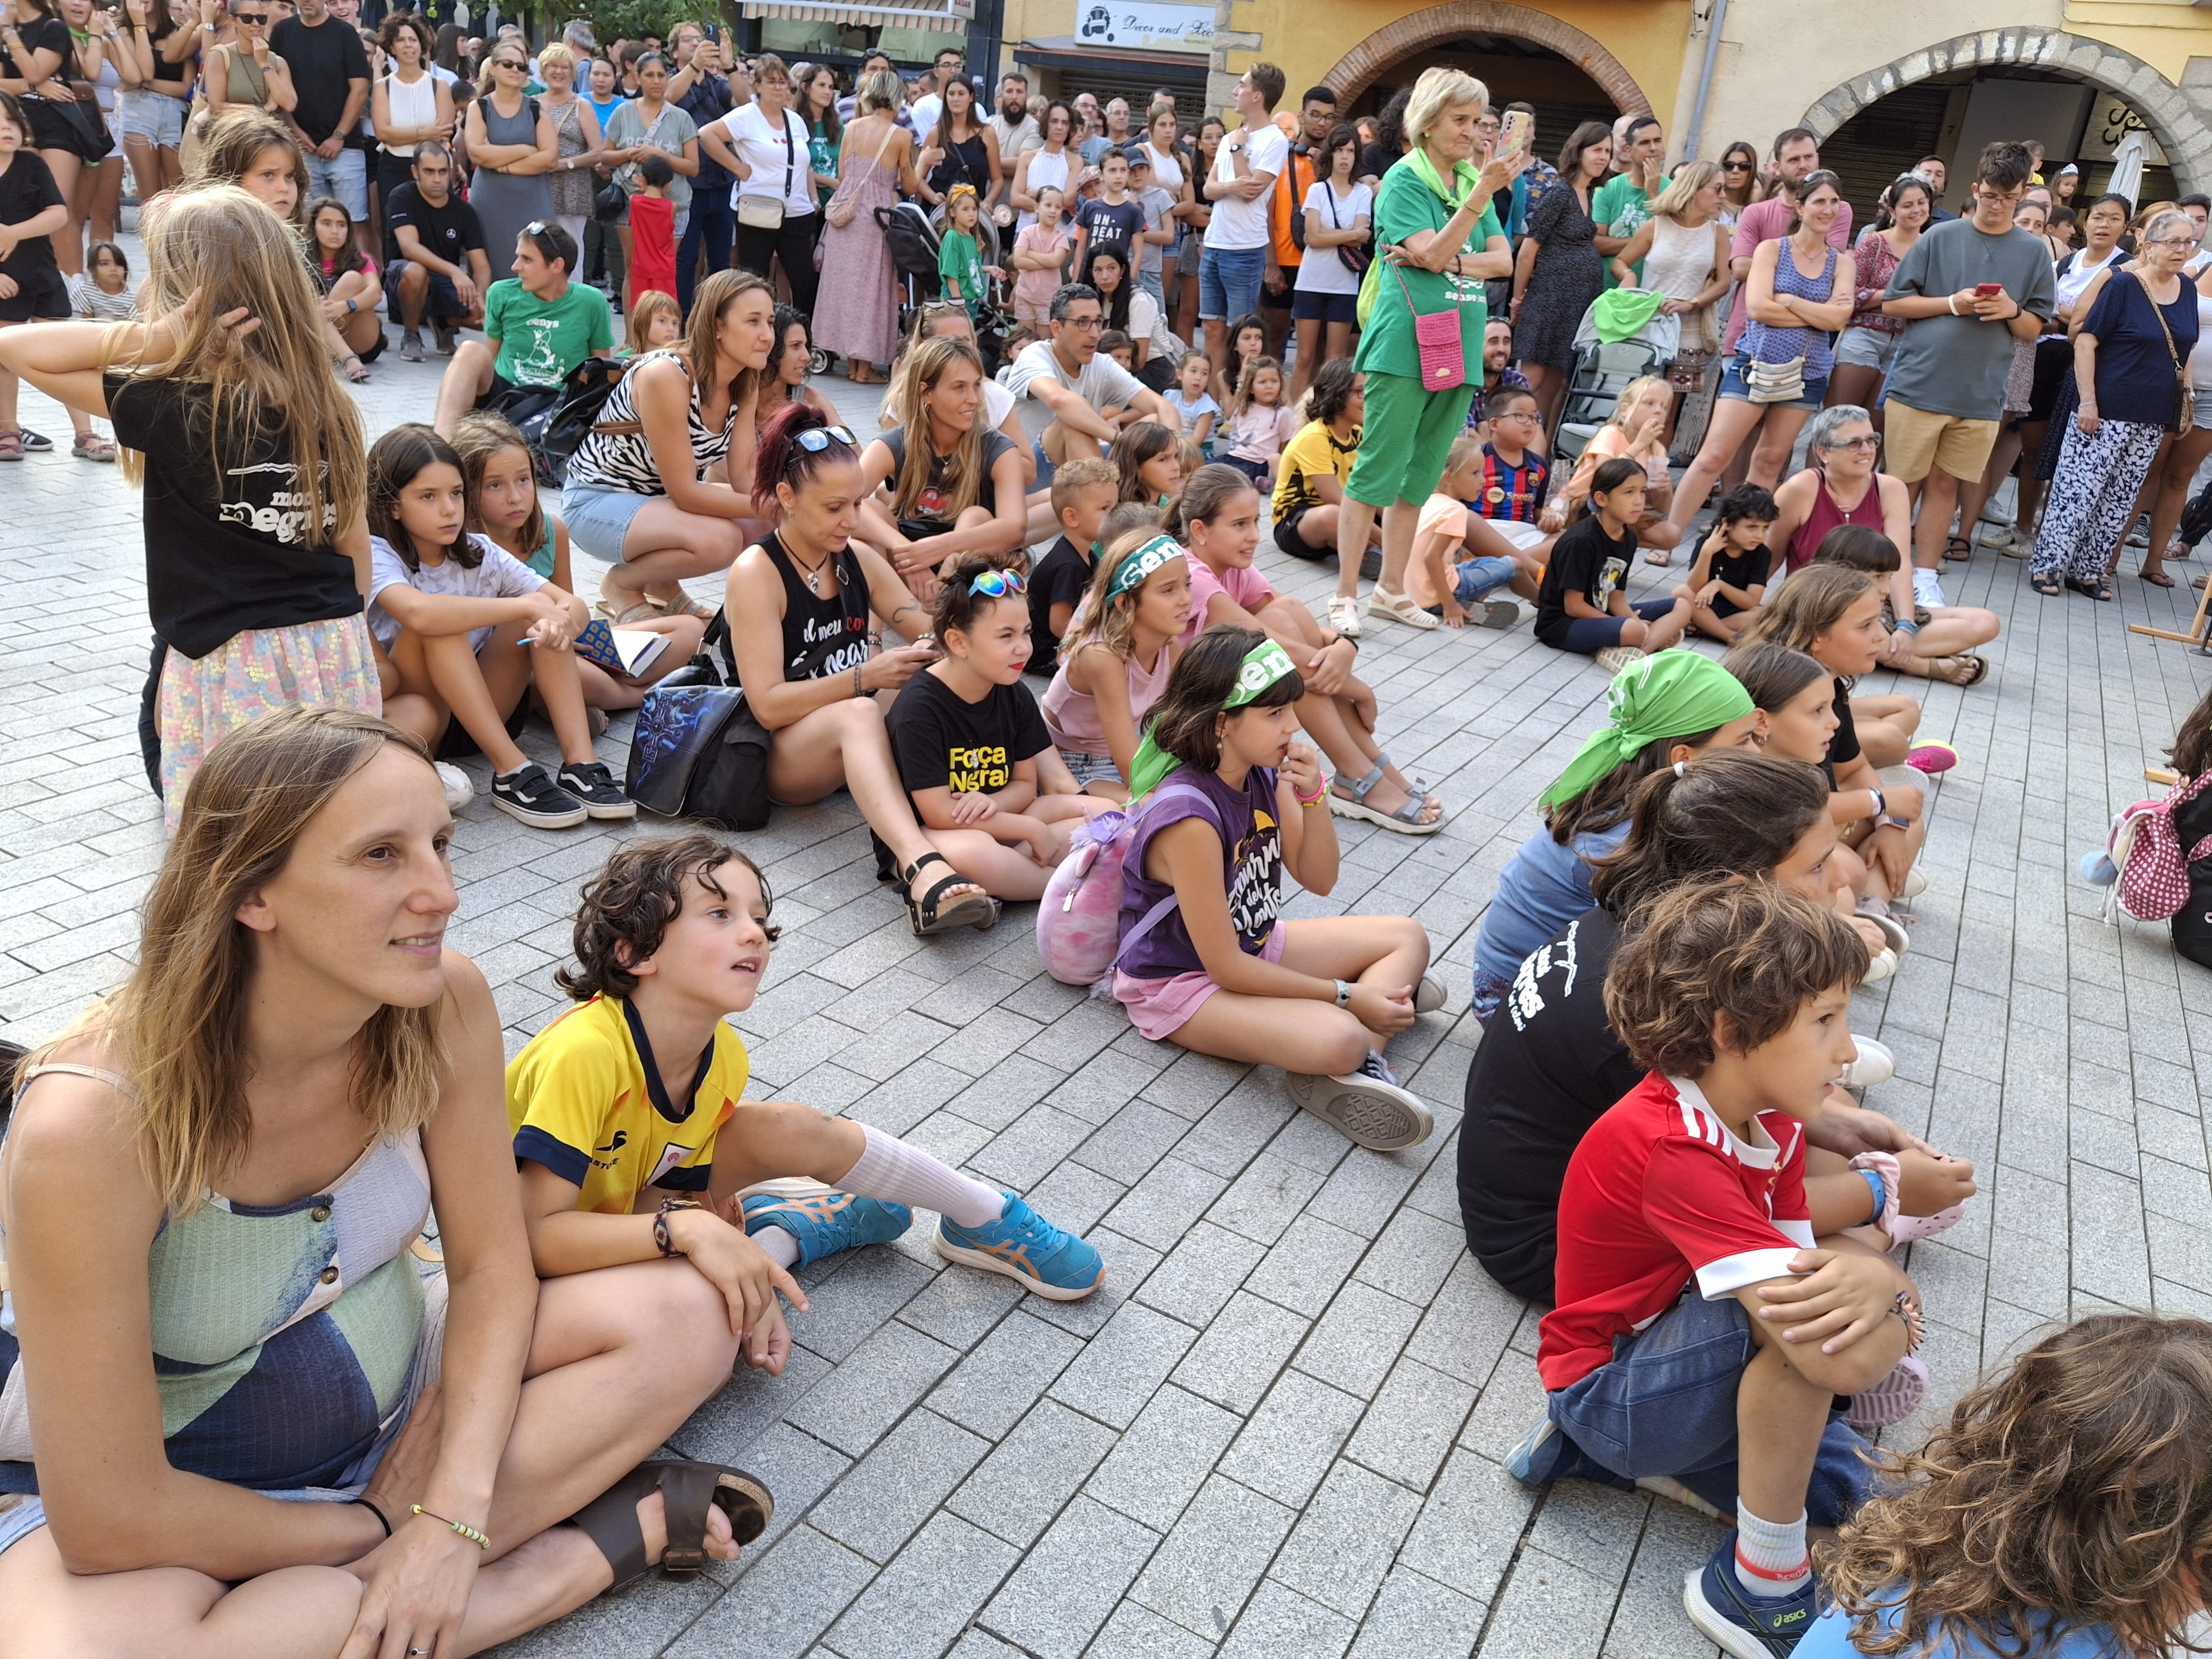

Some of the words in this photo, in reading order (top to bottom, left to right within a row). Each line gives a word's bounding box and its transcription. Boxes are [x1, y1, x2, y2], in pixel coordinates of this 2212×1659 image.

[1158, 22, 1184, 35] and
[1091, 226, 1122, 240] BEAT
[803, 618, 816, 643] el
[818, 619, 842, 641] meu
[1246, 879, 1263, 907] del
[1783, 1608, 1807, 1624] asics
